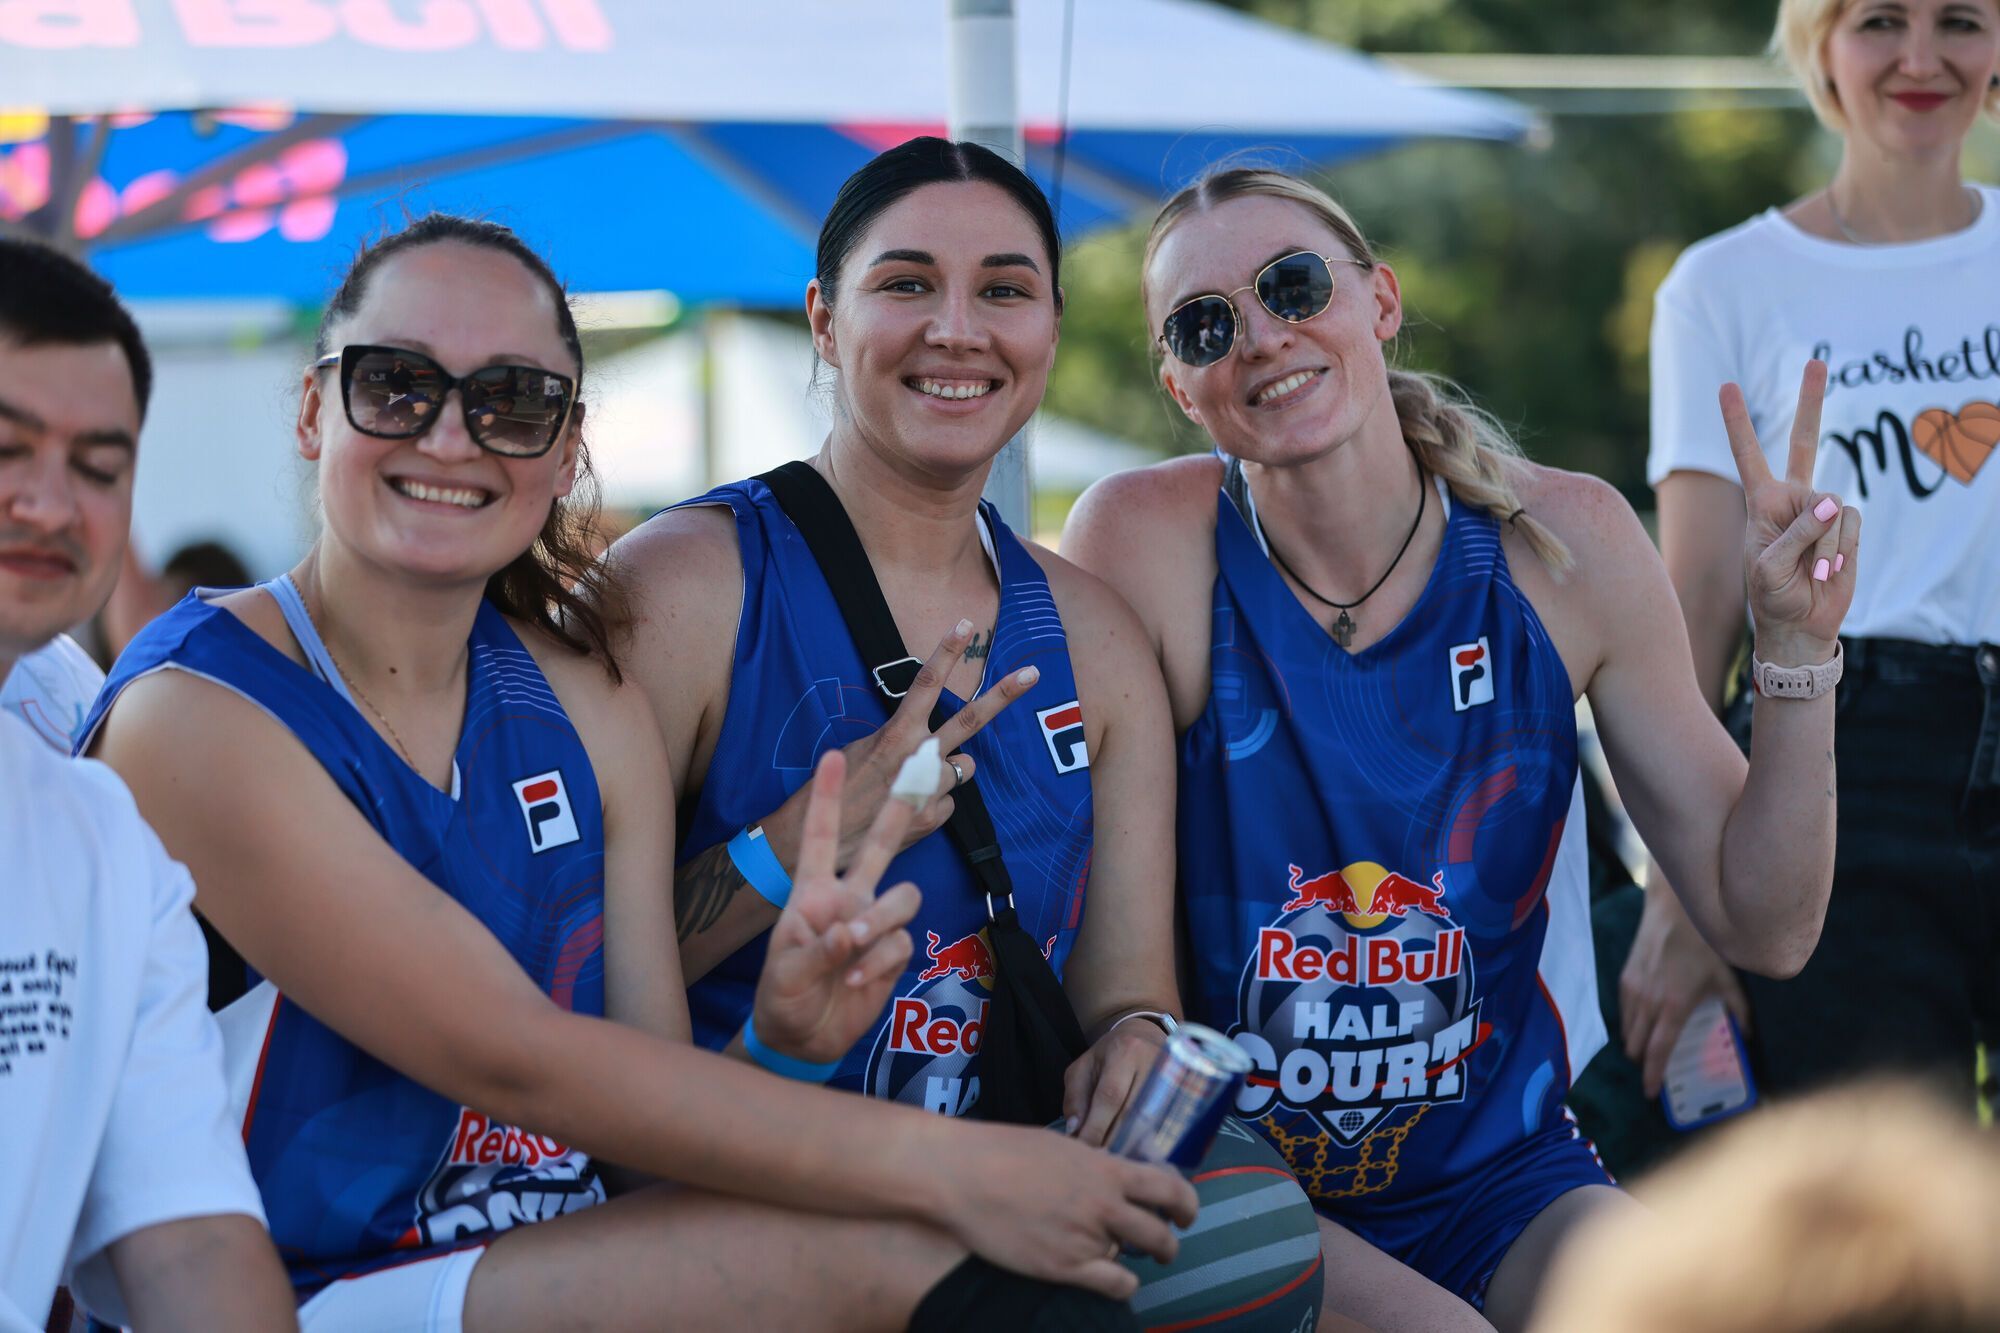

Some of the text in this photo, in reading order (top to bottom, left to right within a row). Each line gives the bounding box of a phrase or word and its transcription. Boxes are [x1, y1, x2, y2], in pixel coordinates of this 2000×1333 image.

[1257, 927, 1465, 986] Red Bull
[889, 999, 990, 1055] Red
[1293, 1000, 1425, 1042] HALF
[1232, 1013, 1475, 1113] COURT
[925, 1077, 980, 1116] HA
